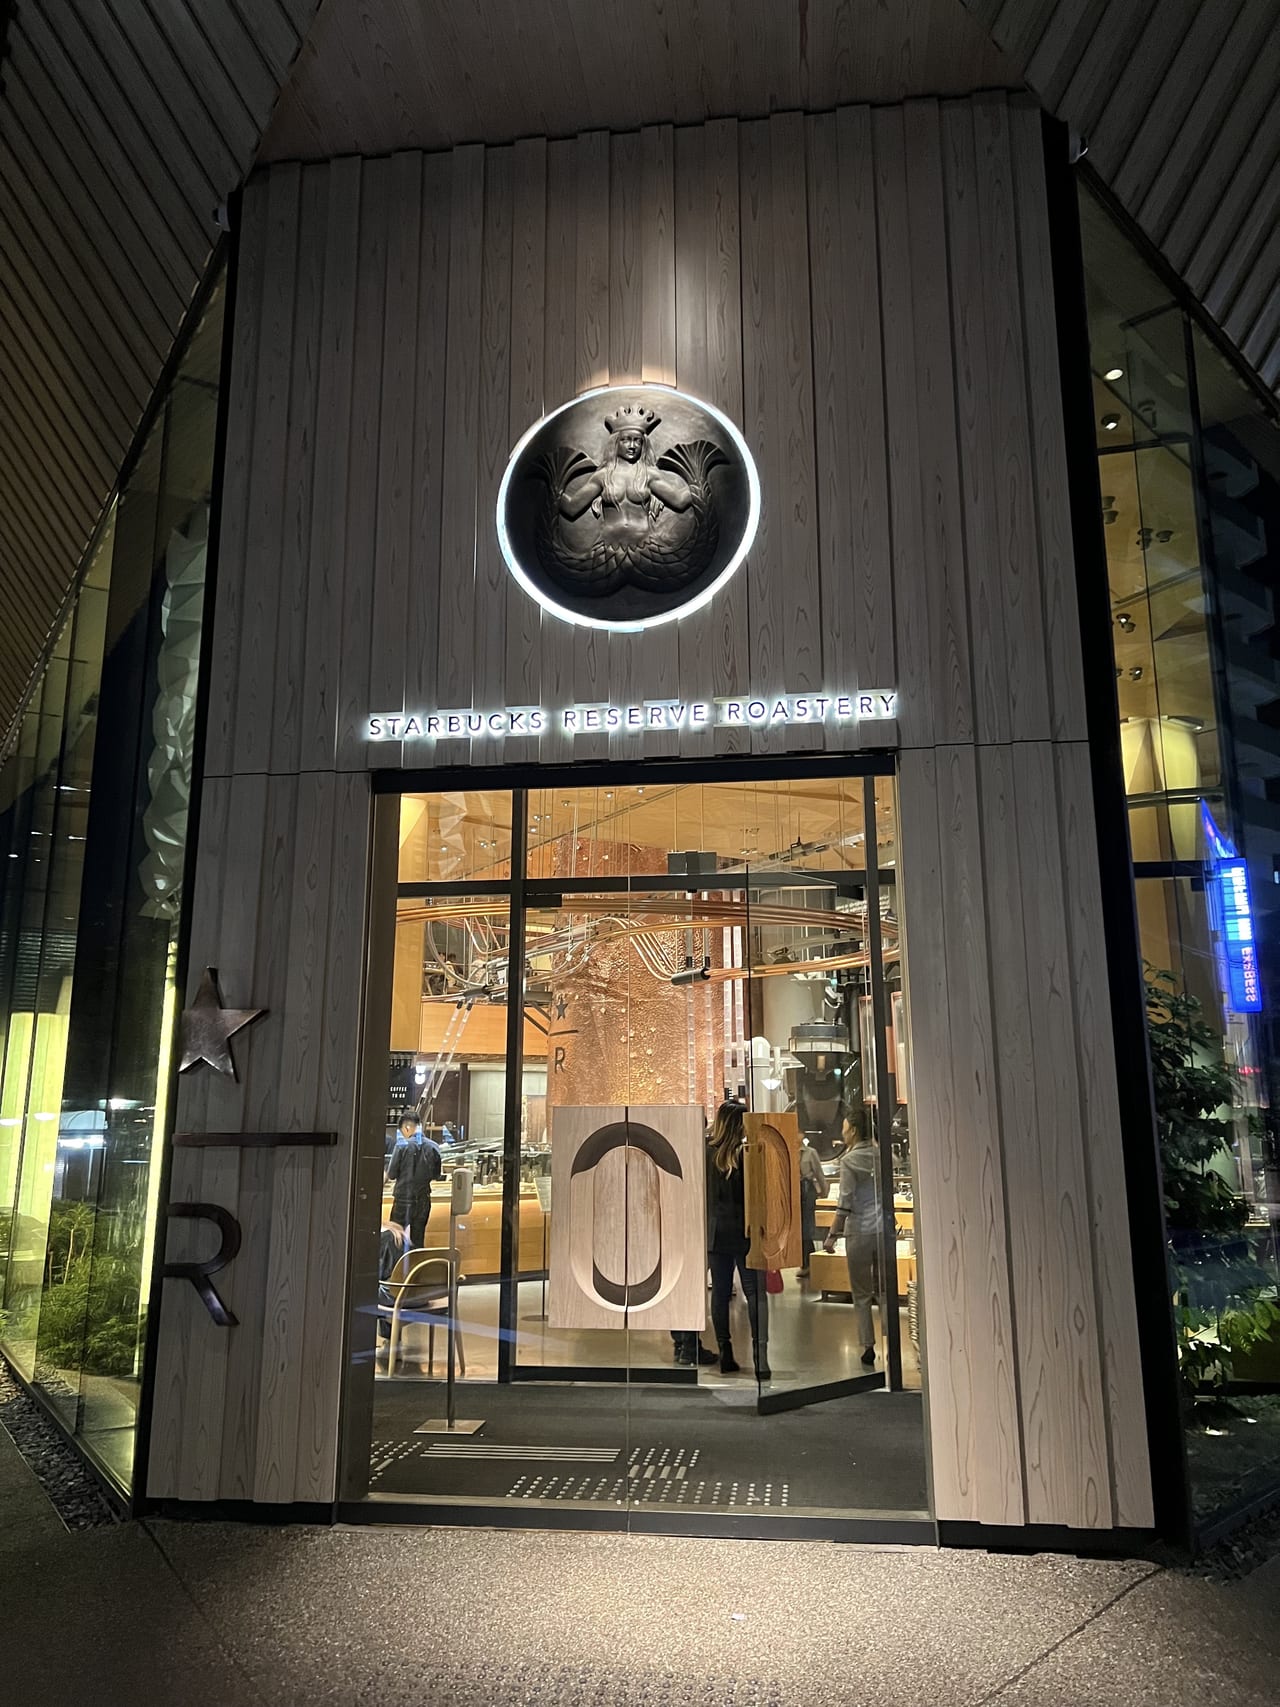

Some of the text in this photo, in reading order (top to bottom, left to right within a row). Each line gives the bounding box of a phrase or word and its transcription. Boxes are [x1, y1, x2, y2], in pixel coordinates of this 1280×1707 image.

[369, 695, 894, 735] STARBUCKS RESERVE ROASTERY
[555, 1047, 566, 1074] R
[161, 1202, 242, 1326] R
